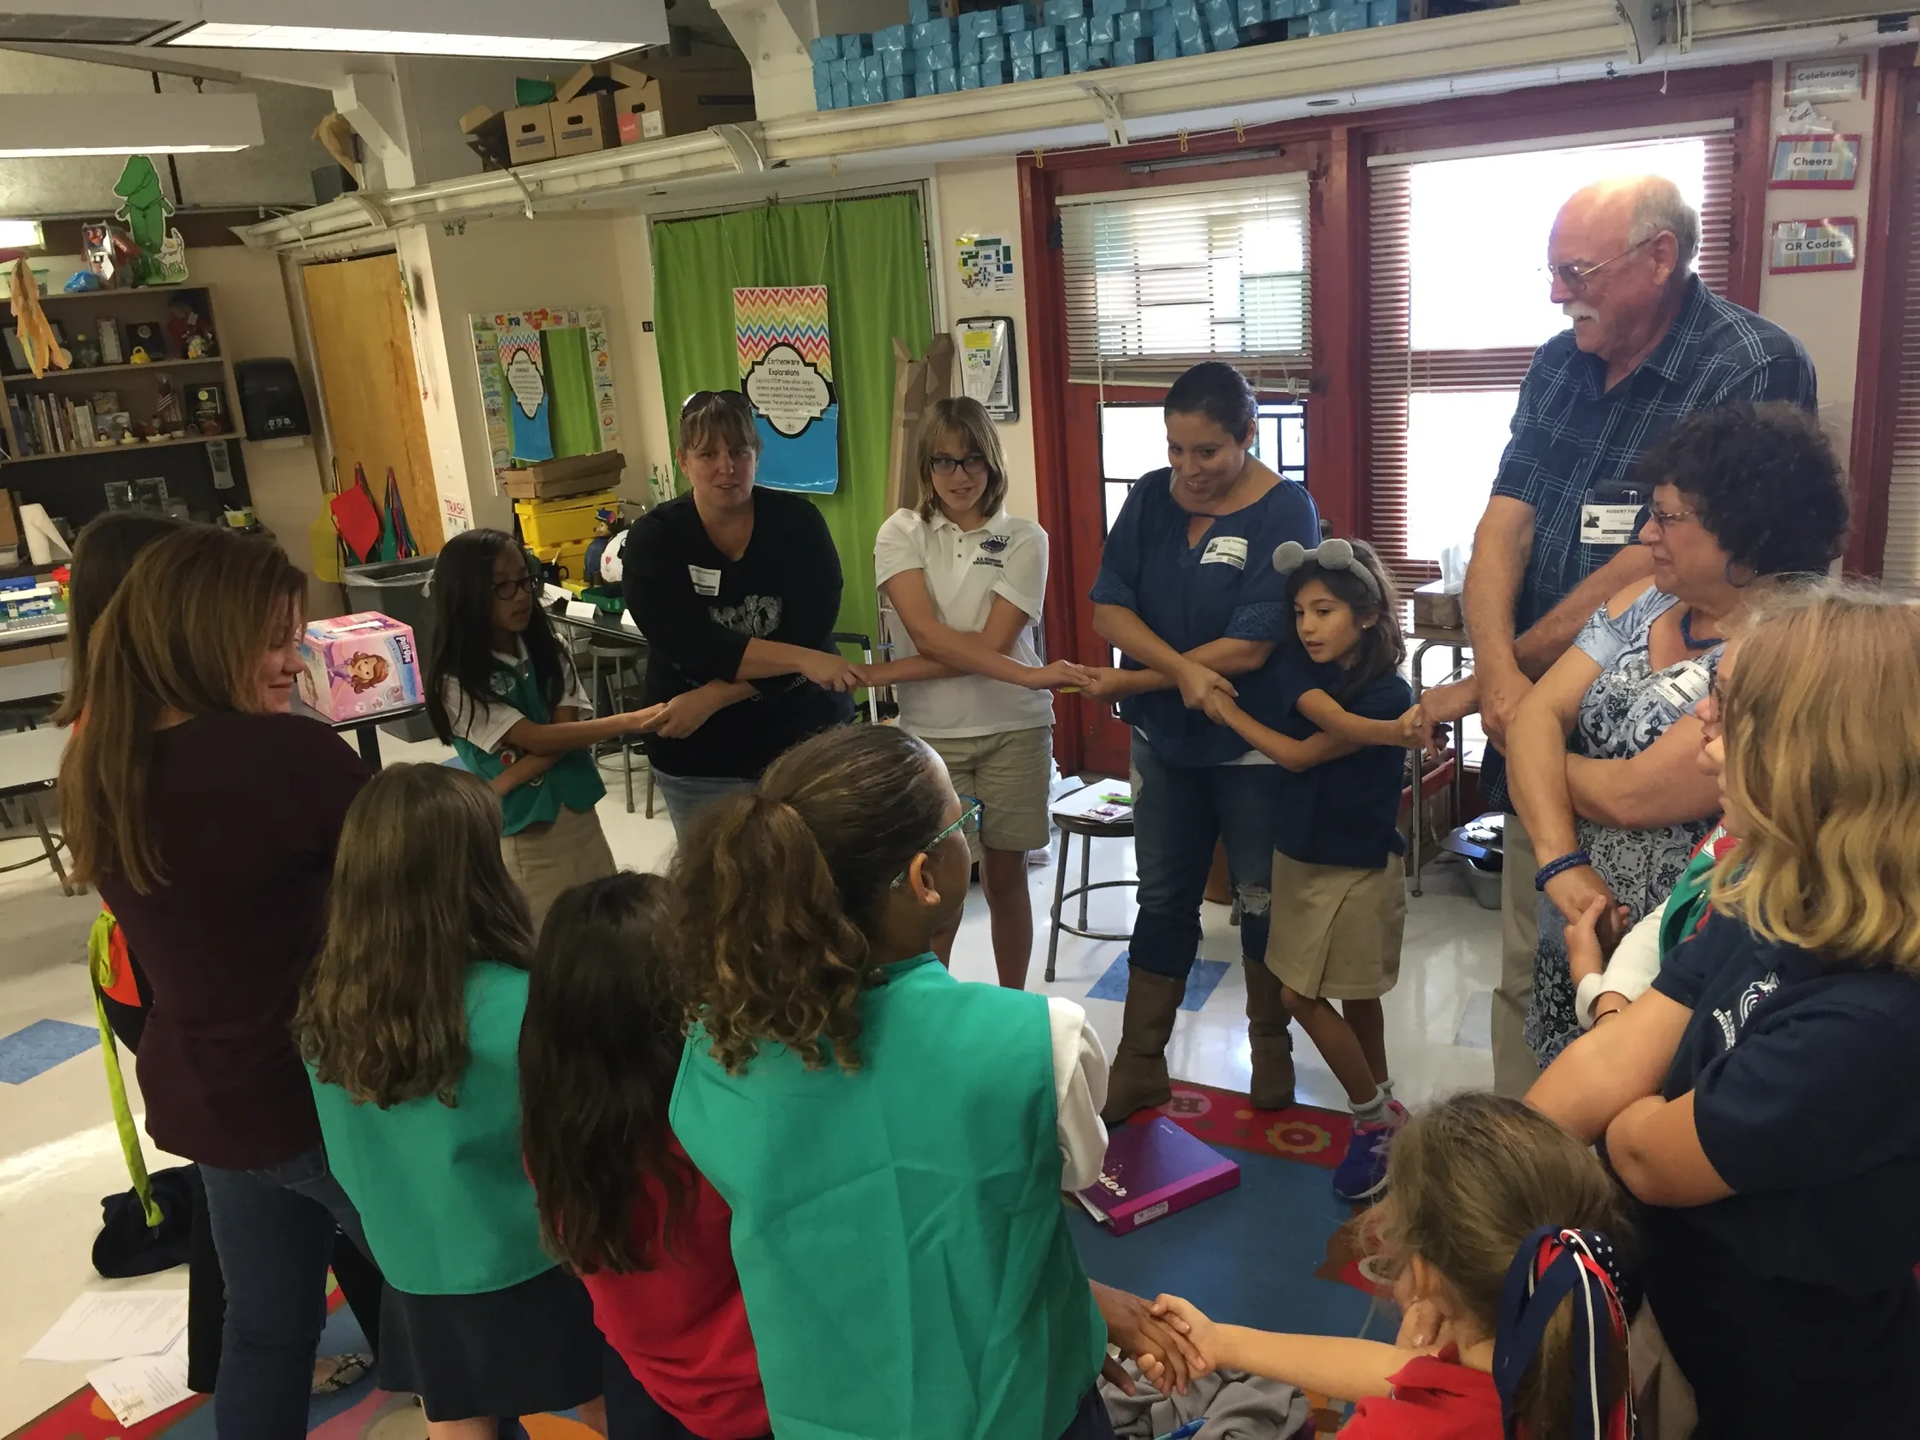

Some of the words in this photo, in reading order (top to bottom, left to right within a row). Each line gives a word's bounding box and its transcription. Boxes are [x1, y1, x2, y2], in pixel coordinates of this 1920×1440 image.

[1797, 69, 1856, 81] Celebrating
[1793, 157, 1834, 166] Cheers
[1785, 242, 1803, 251] QR
[1806, 239, 1842, 250] Codes
[767, 357, 800, 366] Earthenware
[768, 368, 800, 377] Explorations
[444, 499, 466, 516] TRASH
[396, 636, 412, 663] Pull-Ups
